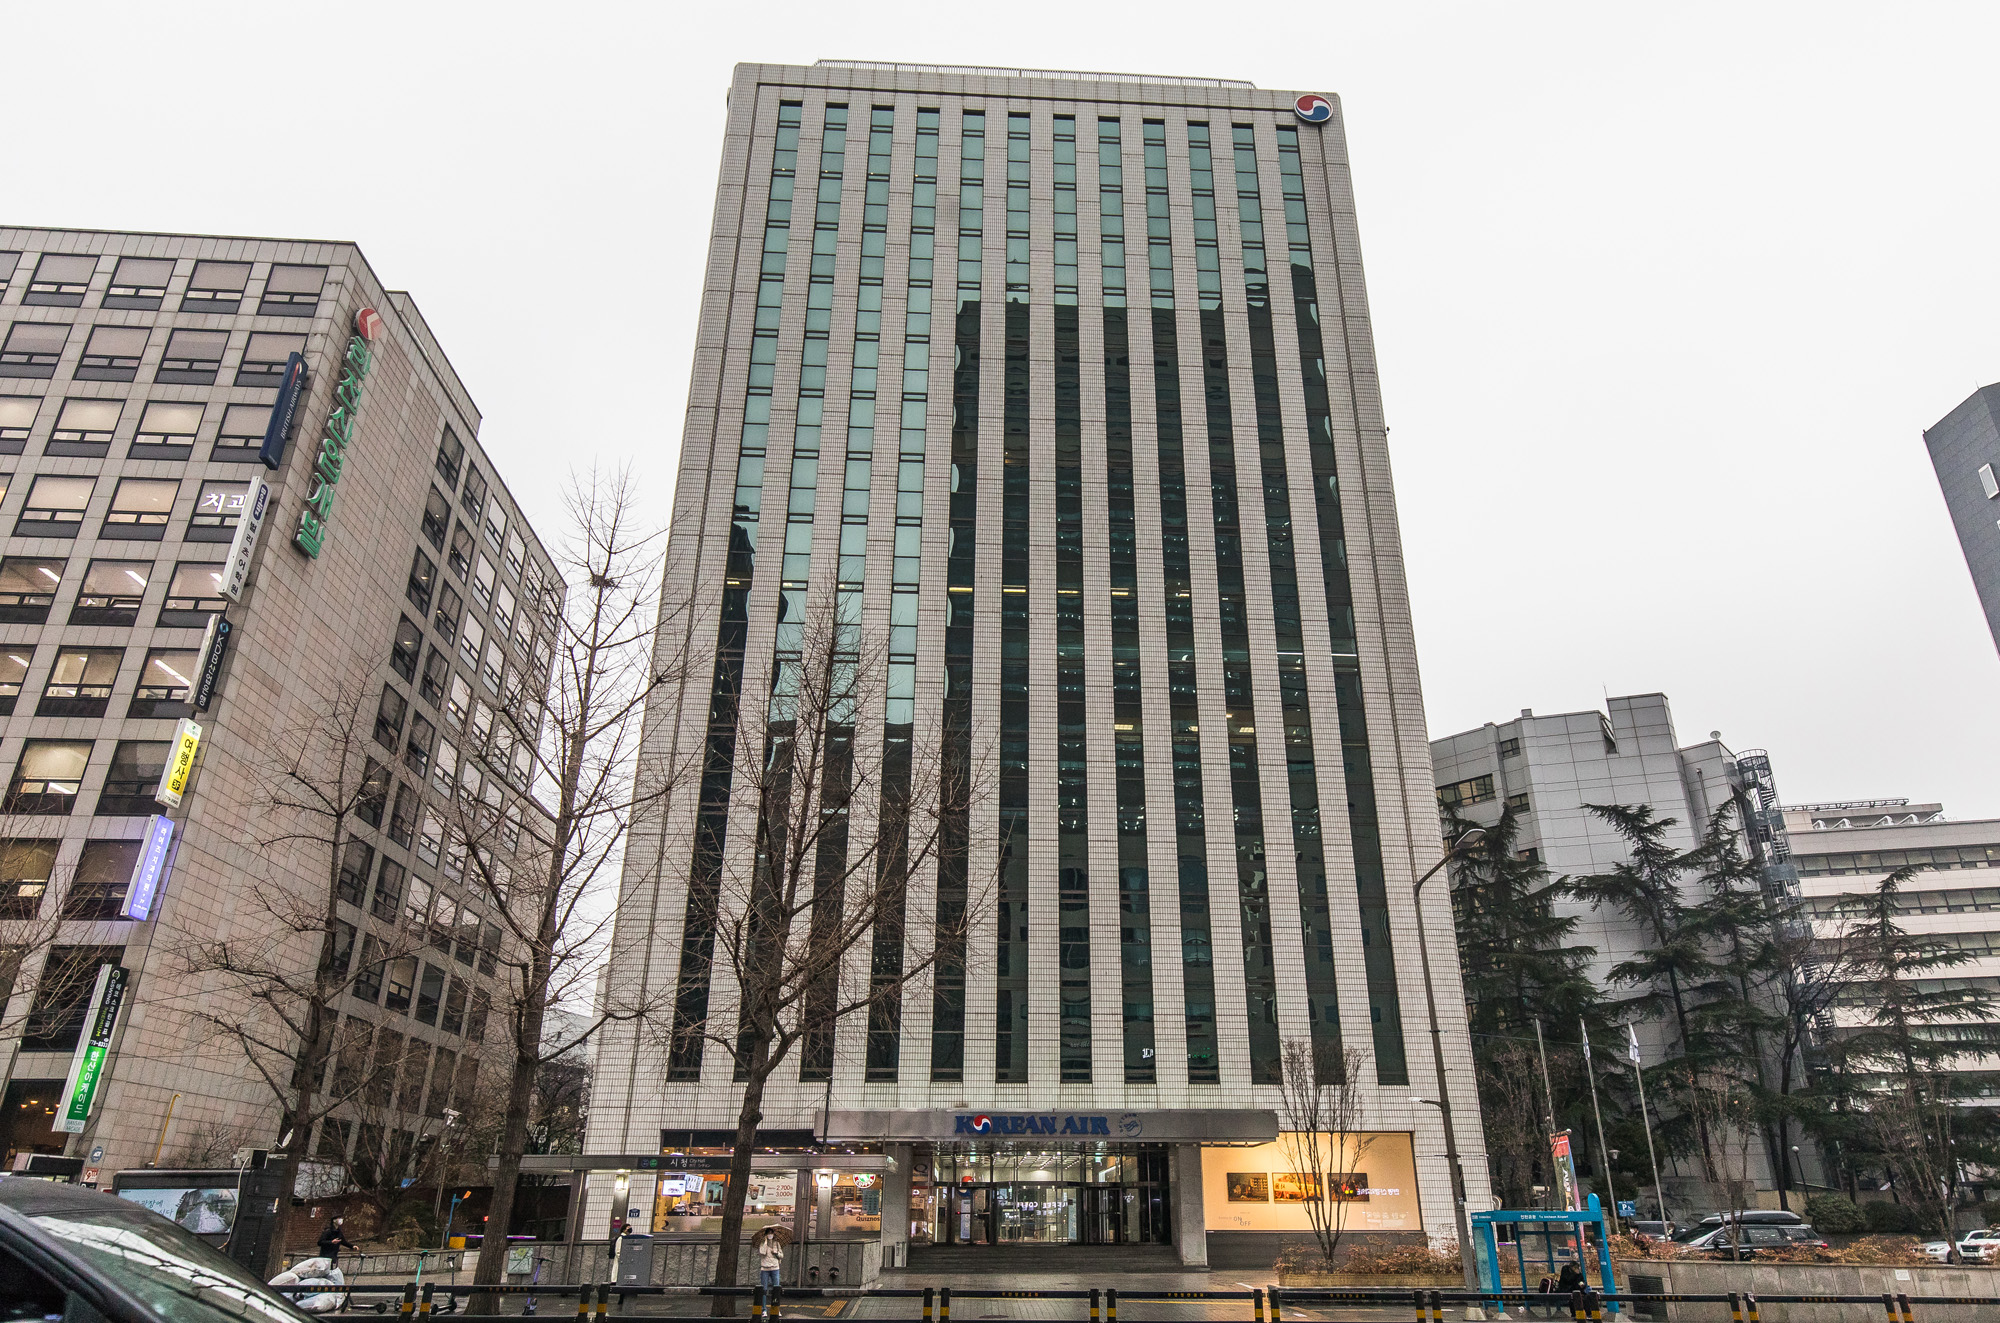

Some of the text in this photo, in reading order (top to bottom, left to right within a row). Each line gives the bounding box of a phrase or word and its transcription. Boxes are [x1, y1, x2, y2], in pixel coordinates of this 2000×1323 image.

[280, 380, 302, 440] BRITISH AIRWAYS
[254, 486, 267, 517] Berlitz
[199, 634, 224, 706] KDB산업은행
[175, 738, 194, 779] 여행사
[74, 1051, 99, 1113] 한산아케이드
[954, 1114, 1111, 1135] KOREAN AIR
